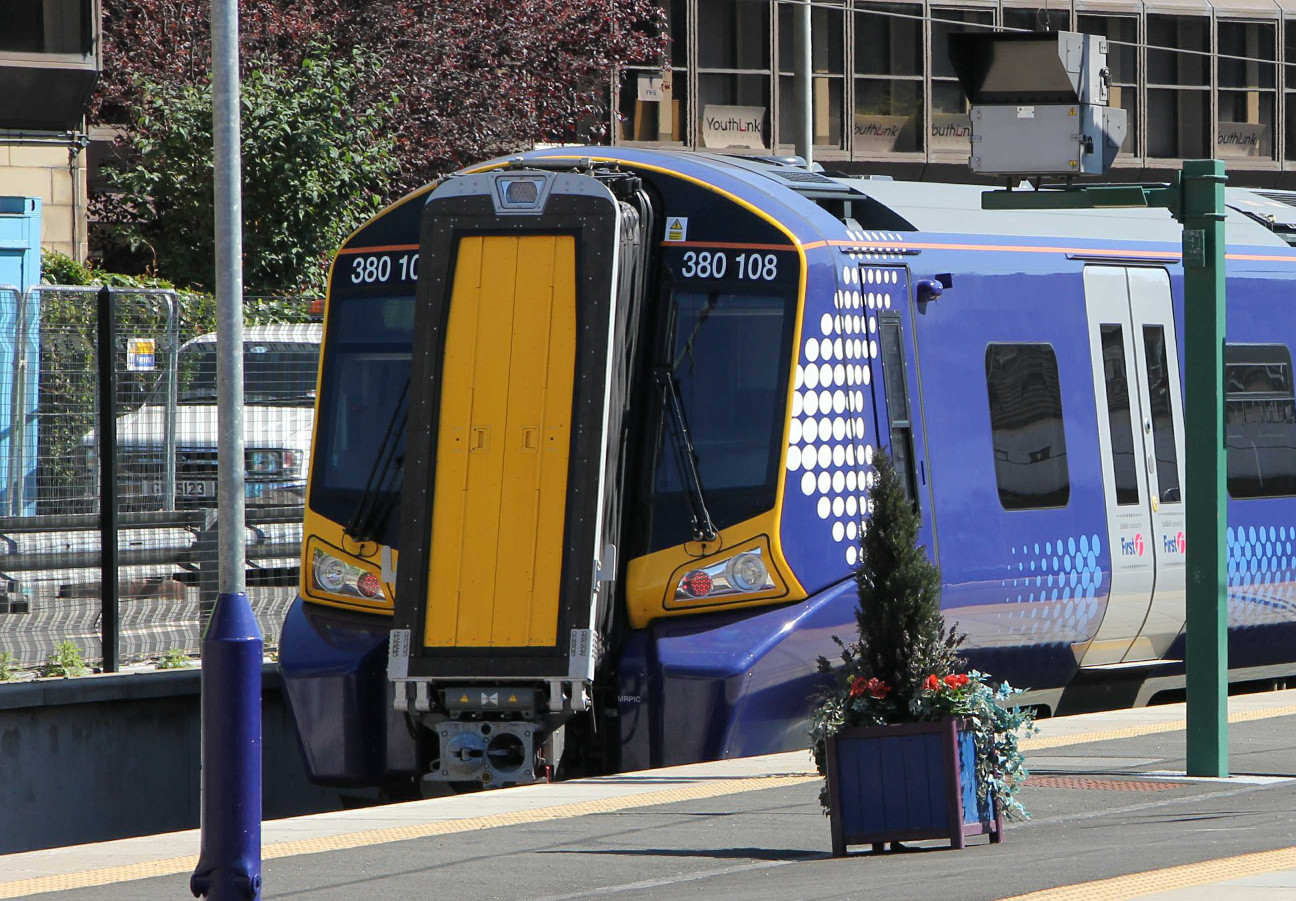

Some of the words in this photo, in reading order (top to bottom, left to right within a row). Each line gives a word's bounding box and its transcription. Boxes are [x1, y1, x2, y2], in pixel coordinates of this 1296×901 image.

[706, 116, 761, 132] YouthLink
[854, 123, 898, 137] outhLink
[931, 123, 970, 137] outhLin
[1217, 132, 1257, 145] outhLink
[351, 255, 391, 284] 380
[399, 254, 420, 281] 10
[681, 251, 727, 278] 380
[736, 253, 778, 280] 108
[1120, 536, 1136, 556] First
[1162, 534, 1178, 554] First
